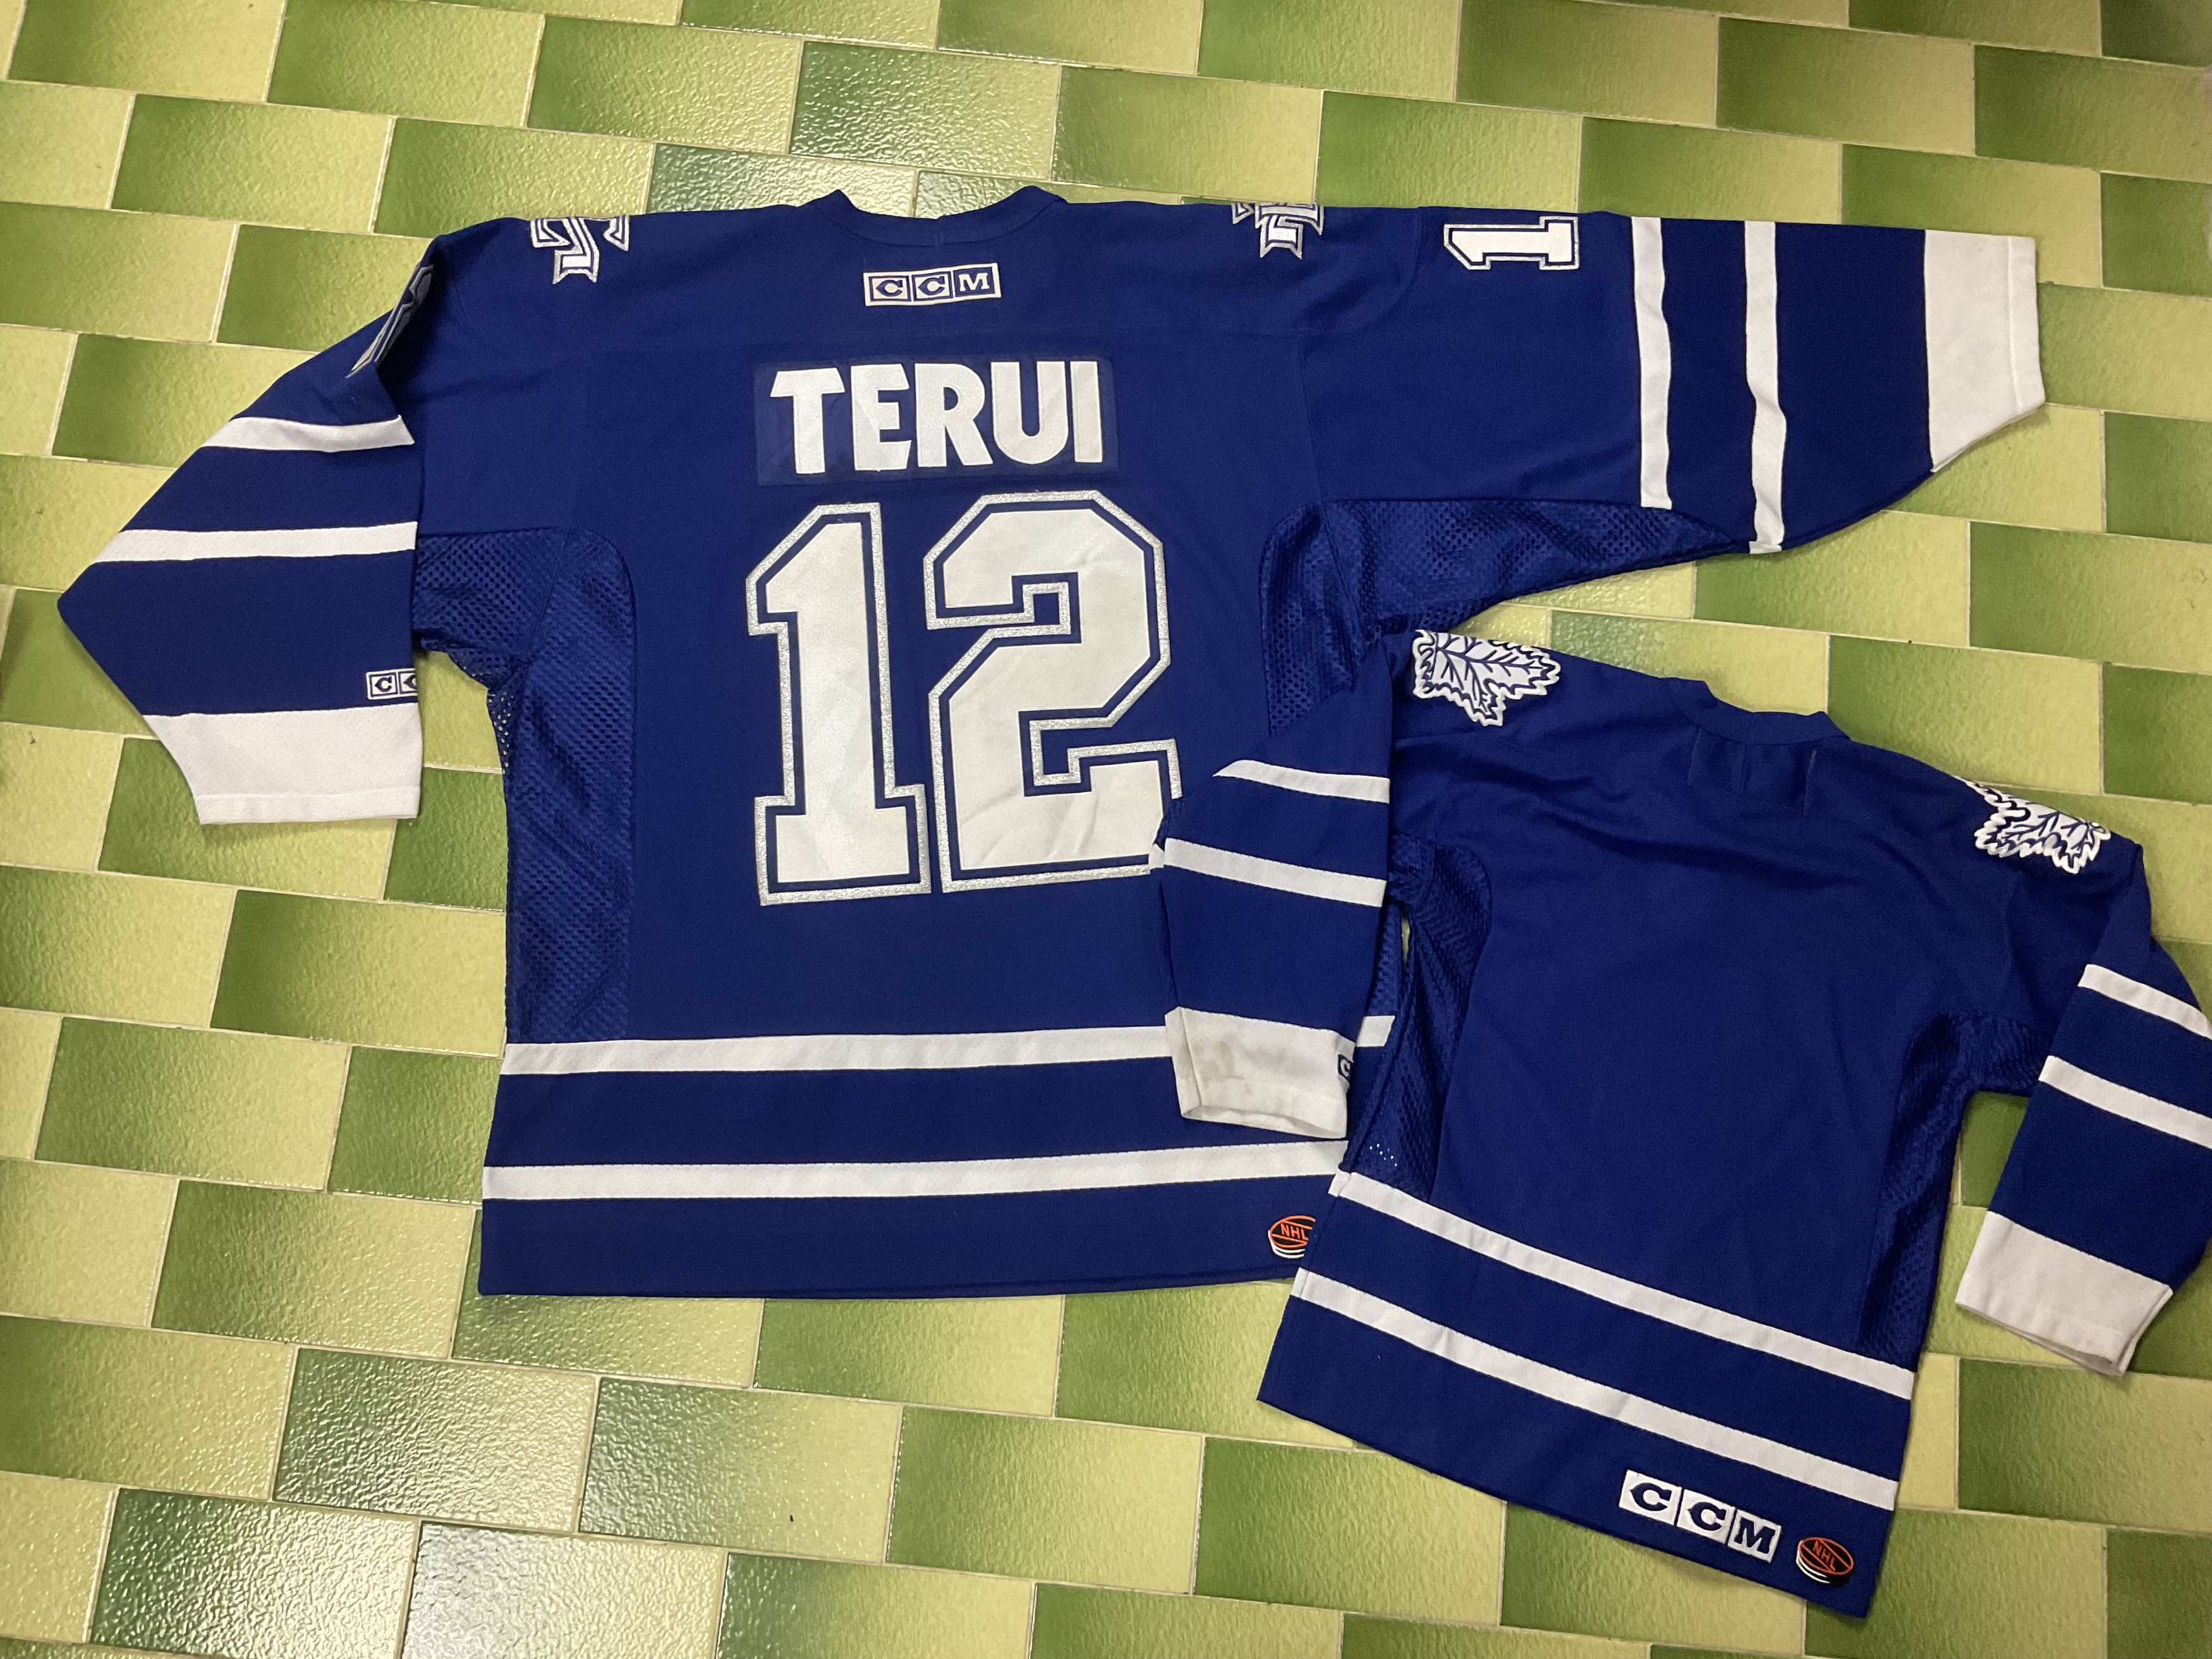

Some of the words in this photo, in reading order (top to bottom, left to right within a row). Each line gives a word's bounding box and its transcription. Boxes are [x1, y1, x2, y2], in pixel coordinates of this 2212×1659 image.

[874, 271, 992, 298] CCM
[770, 360, 1104, 474] TERUI
[746, 490, 1182, 906] 12
[1280, 1222, 1309, 1241] NHL
[1629, 1482, 1776, 1554] CCM
[1812, 1540, 1837, 1572] NHL
